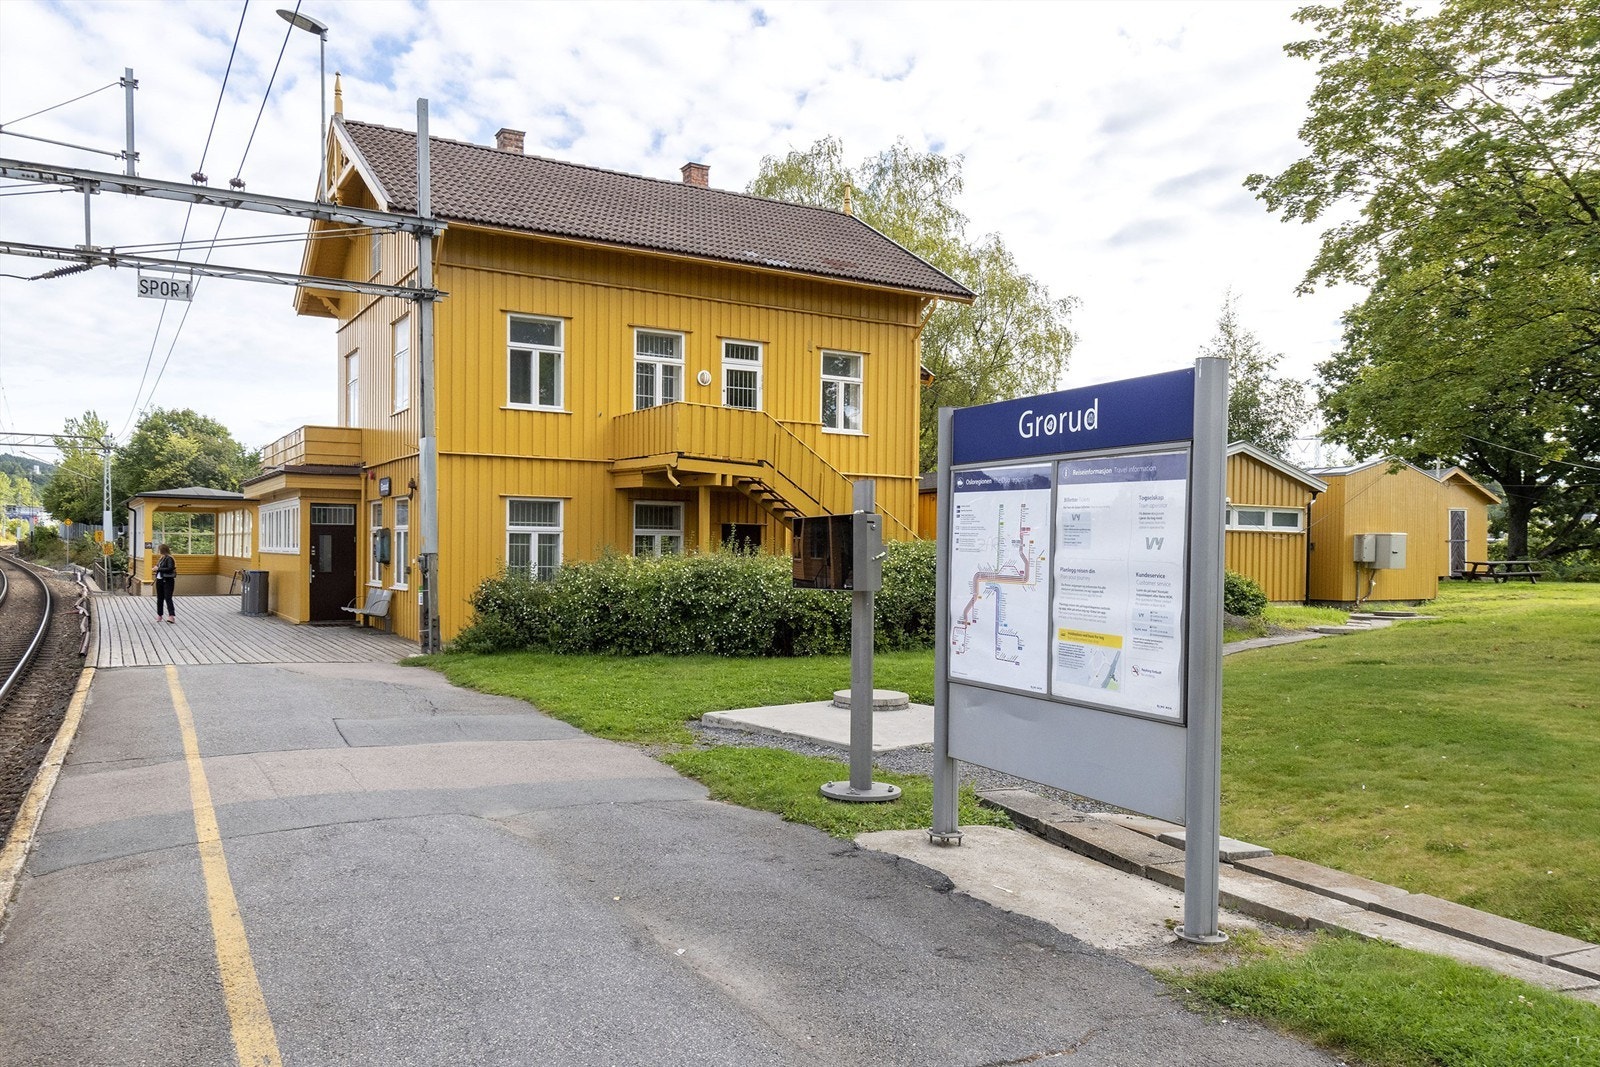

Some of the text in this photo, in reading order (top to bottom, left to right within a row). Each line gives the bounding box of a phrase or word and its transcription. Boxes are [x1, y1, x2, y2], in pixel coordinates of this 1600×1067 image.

[140, 279, 190, 298] SPOR 1
[1018, 398, 1098, 439] Grorud
[1072, 466, 1112, 476] Reiseinformasjon
[1128, 464, 1156, 472] information
[966, 478, 992, 487] Osloregionen
